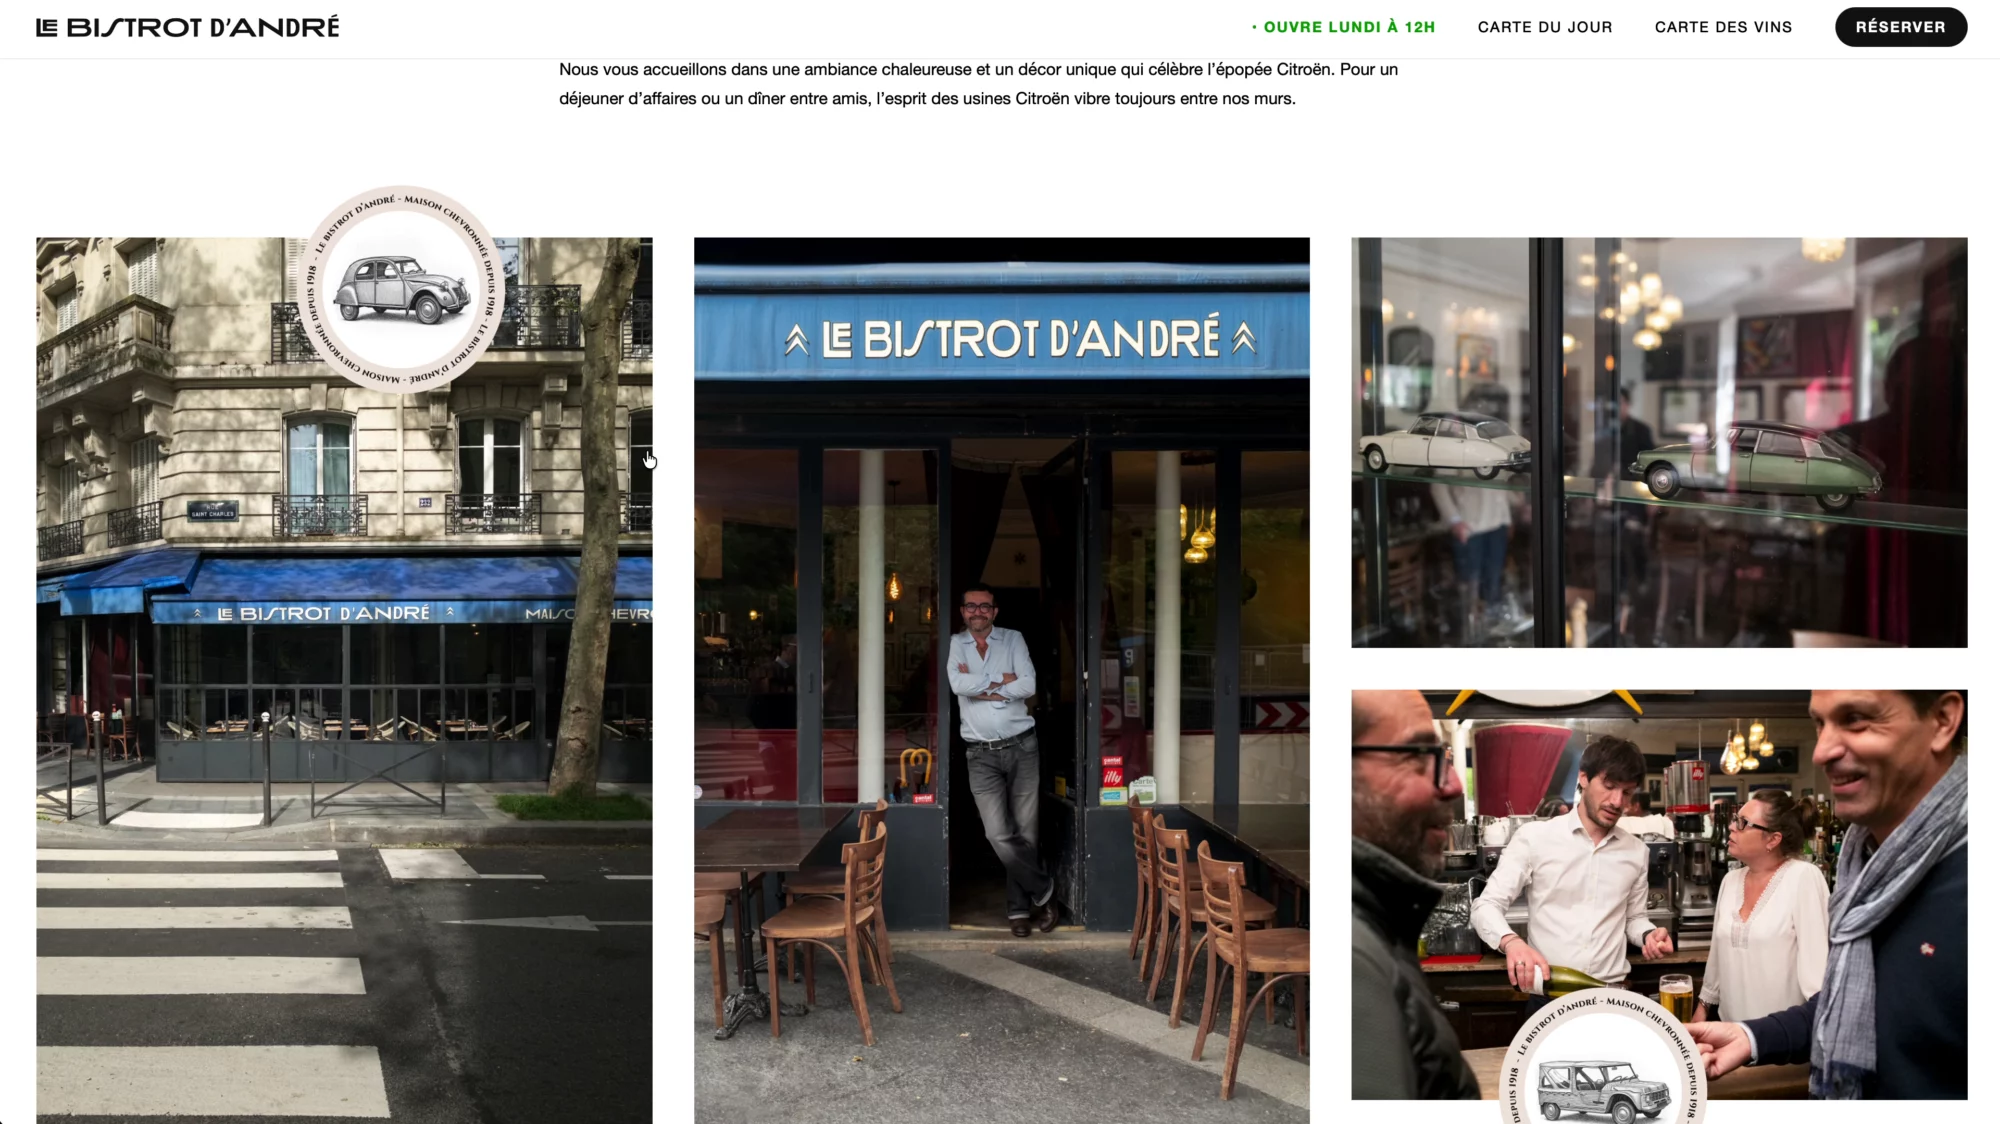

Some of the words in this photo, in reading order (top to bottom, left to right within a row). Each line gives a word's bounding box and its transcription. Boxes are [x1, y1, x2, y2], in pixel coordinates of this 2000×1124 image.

[36, 18, 57, 37] LE
[68, 18, 202, 37] BISTROT
[211, 14, 339, 37] D'ANDRÉ
[1264, 21, 1322, 33] OUVRE
[1329, 21, 1380, 33] LUNDI
[1387, 17, 1399, 33] À
[1405, 21, 1435, 33] 12H
[1478, 21, 1531, 33] CARTE
[1539, 21, 1560, 33] DU
[1568, 21, 1612, 33] JOUR
[1655, 21, 1708, 33] CARTE
[1716, 21, 1747, 33] DES
[1754, 21, 1792, 33] VINS
[1856, 18, 1944, 33] RÉSERVER
[560, 63, 598, 76] Nous
[603, 66, 638, 76] vous
[644, 63, 726, 76] accueillons
[732, 63, 768, 75] dans
[773, 66, 800, 76] une
[805, 63, 877, 76] ambiance
[882, 63, 972, 76] chaleureuse
[976, 63, 990, 75] et
[996, 66, 1013, 75] un
[1019, 62, 1062, 75] décor
[1067, 63, 1116, 79] unique
[1121, 63, 1143, 79] qui
[1149, 62, 1203, 75] célèbre
[1208, 62, 1272, 79] l’épopée
[1277, 62, 1334, 76] Citroën.
[1341, 63, 1375, 75] Pour
[1381, 66, 1398, 75] un
[560, 91, 624, 108] déjeuner
[629, 92, 696, 105] d’affaires
[702, 95, 719, 105] ou
[725, 95, 743, 105] un
[748, 92, 786, 105] dîner
[790, 93, 828, 105] entre
[833, 92, 871, 107] amis,
[877, 92, 927, 108] l’esprit
[932, 92, 958, 105] des
[964, 92, 1011, 105] usines
[1016, 92, 1069, 105] Citroën
[1074, 92, 1110, 105] vibre
[1115, 92, 1175, 108] toujours
[1180, 93, 1218, 105] entre
[1223, 95, 1249, 105] nos
[1255, 95, 1295, 105] murs.
[822, 320, 853, 359] LE
[864, 319, 1041, 359] BISTROT
[1050, 311, 1221, 358] D'ANDRÉ
[217, 607, 233, 621] LE
[240, 606, 331, 621] BISTROT
[340, 604, 430, 621] D'ANDRÉ
[1104, 770, 1121, 786] illy
